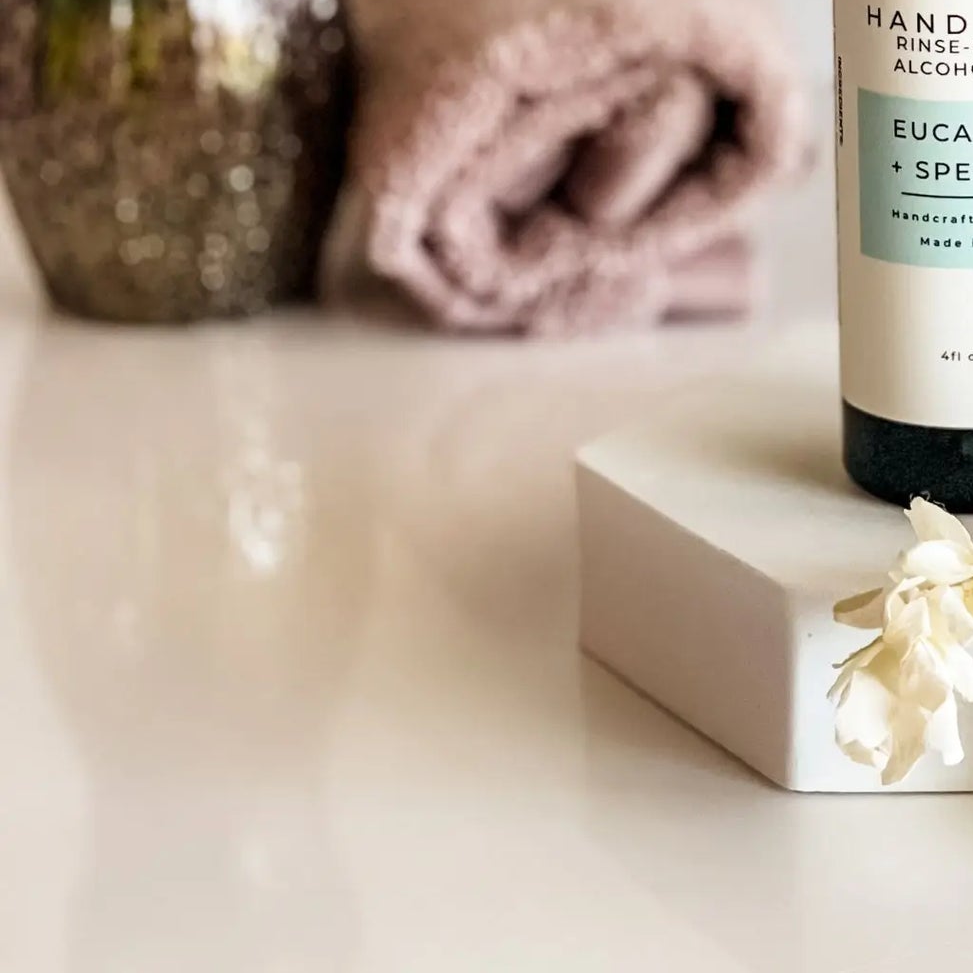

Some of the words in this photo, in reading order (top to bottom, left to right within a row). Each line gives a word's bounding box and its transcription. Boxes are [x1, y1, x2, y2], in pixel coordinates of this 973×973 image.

[867, 5, 967, 35] HAND
[892, 161, 902, 173] +
[920, 237, 962, 248] Made
[941, 350, 961, 361] 4fl
